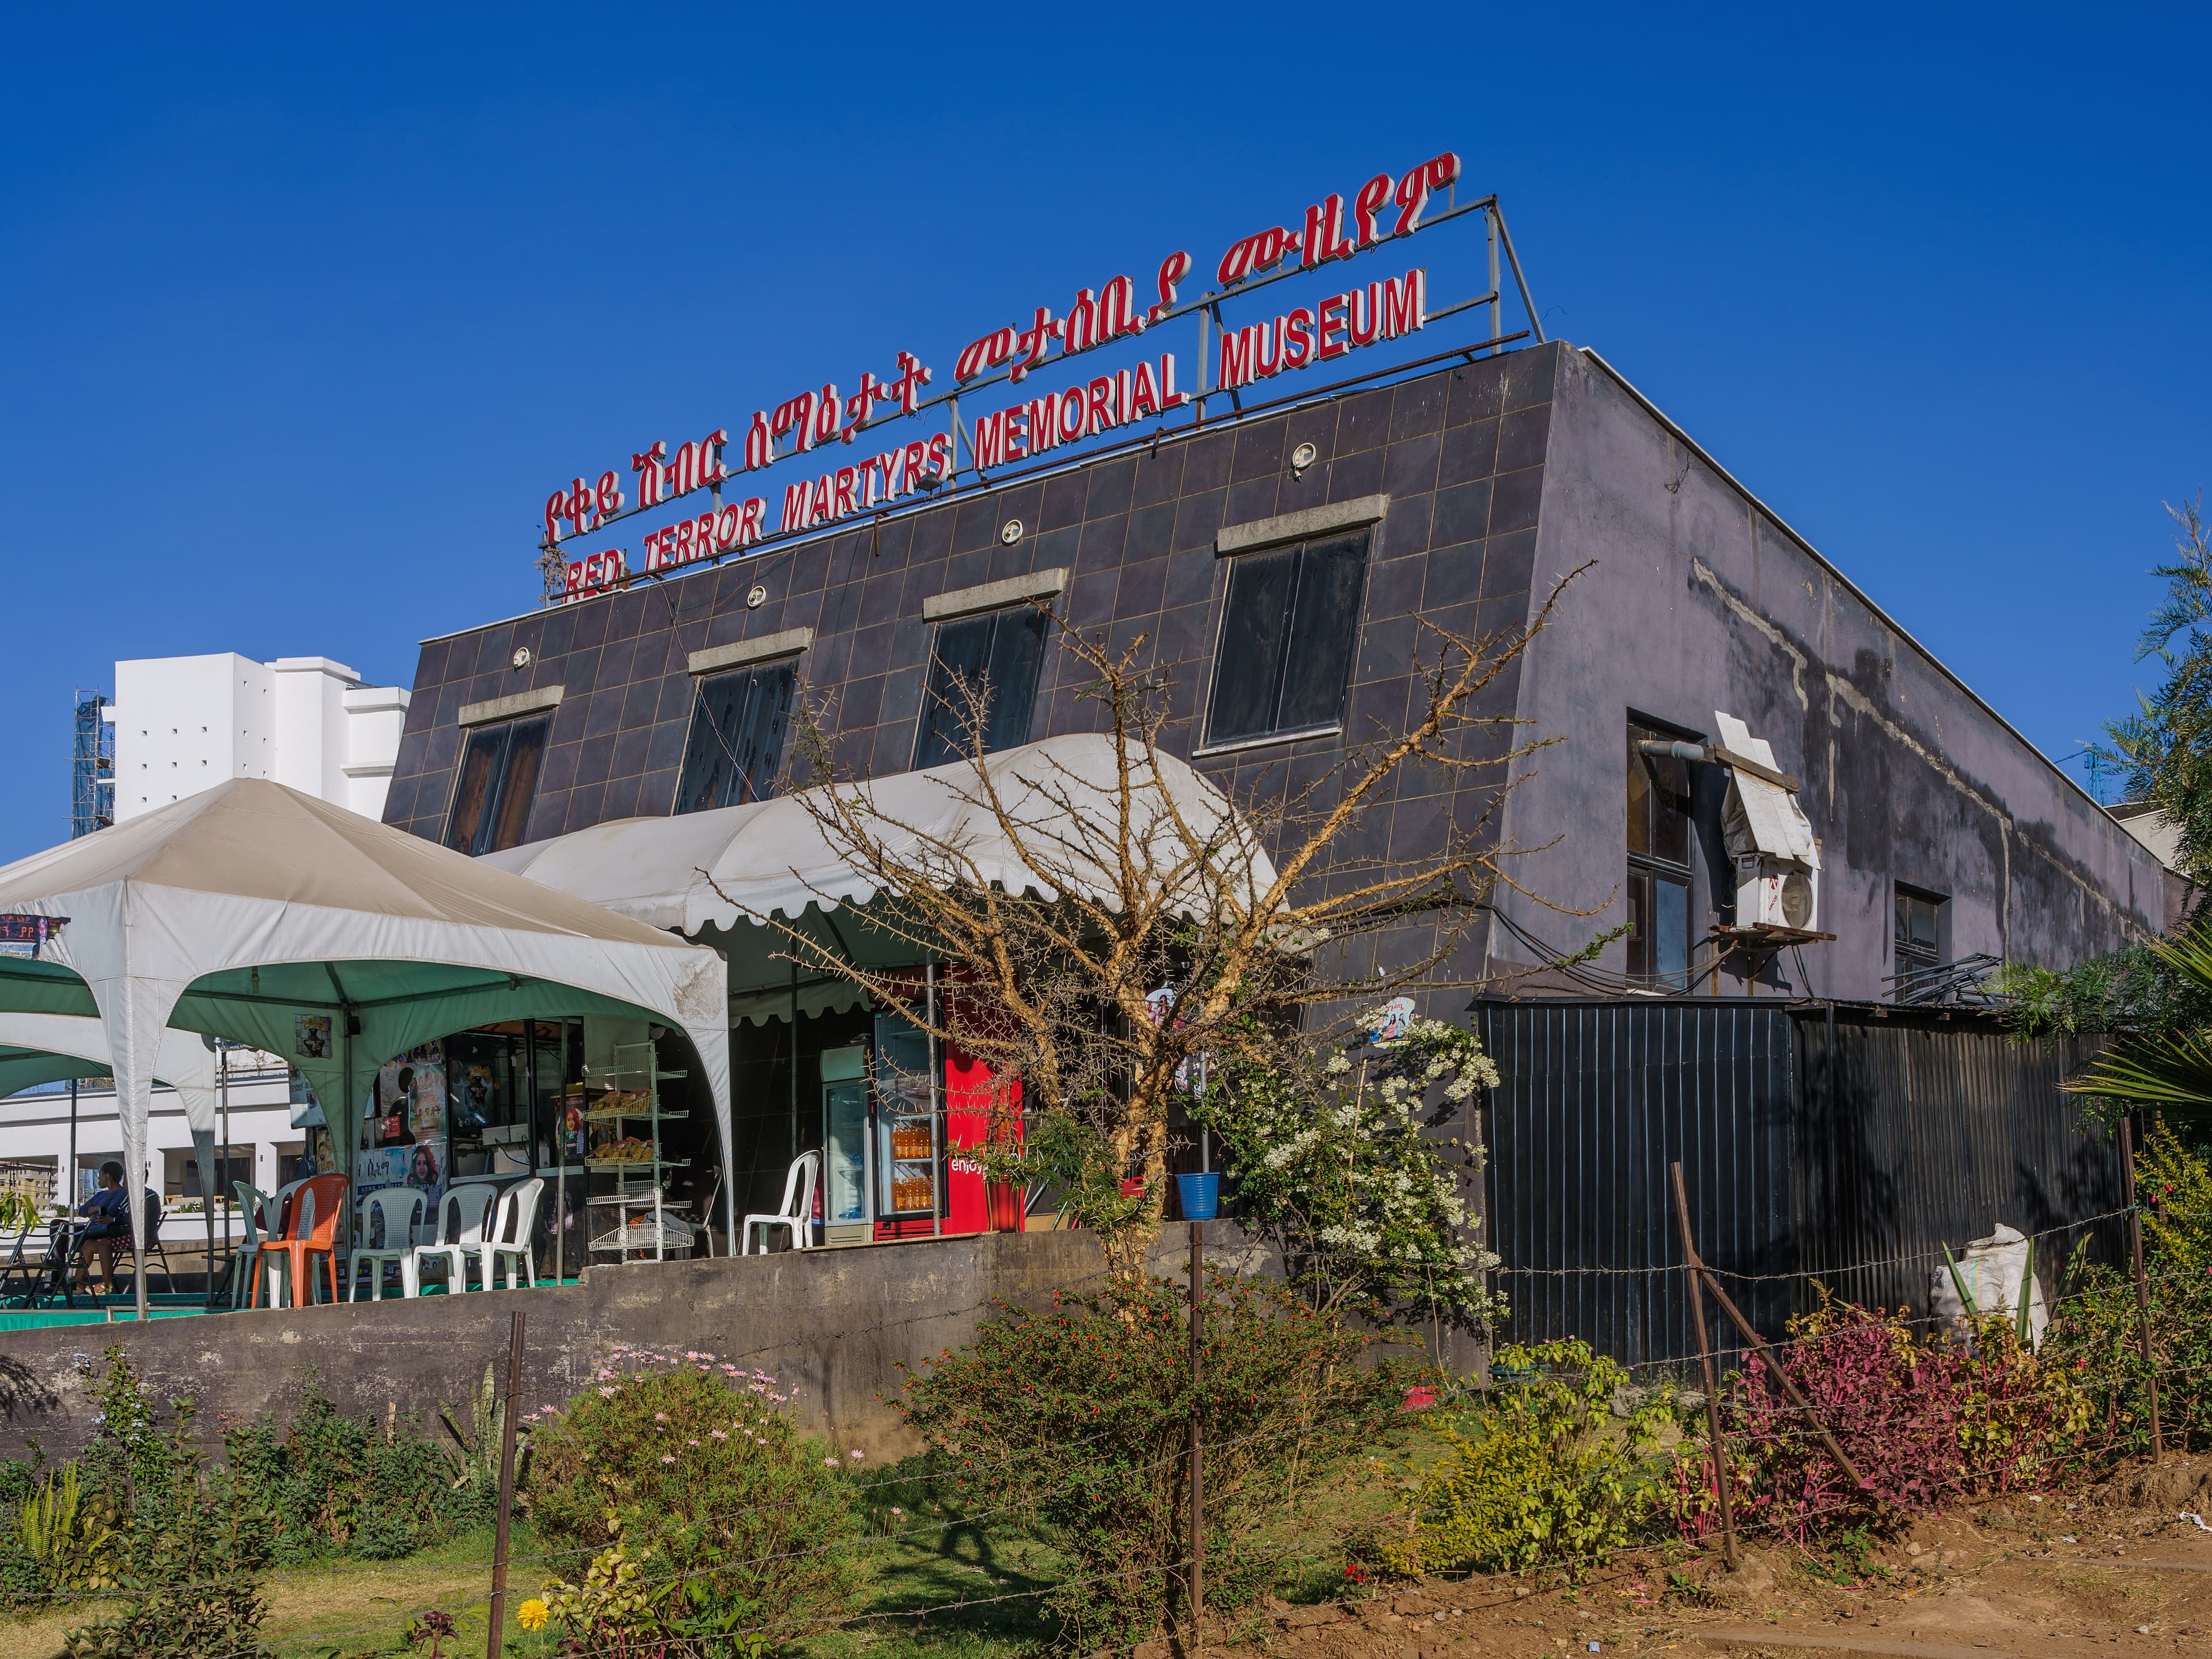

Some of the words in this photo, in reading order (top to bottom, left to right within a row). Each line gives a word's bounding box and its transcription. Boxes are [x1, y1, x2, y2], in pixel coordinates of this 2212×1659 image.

[546, 471, 624, 545] የቀይ
[631, 430, 728, 508] ሽብር
[745, 351, 932, 470] ሰማዕታት
[954, 251, 1191, 384] መታሰቢያ
[1217, 152, 1461, 287] ሙዚየም
[563, 549, 626, 604] RED
[643, 497, 766, 572] TERROR
[781, 433, 952, 532] MARTYRS
[974, 353, 1189, 470] MEMORIAL
[1219, 268, 1425, 391] MUSEUM
[951, 1158, 983, 1175] enjoy
